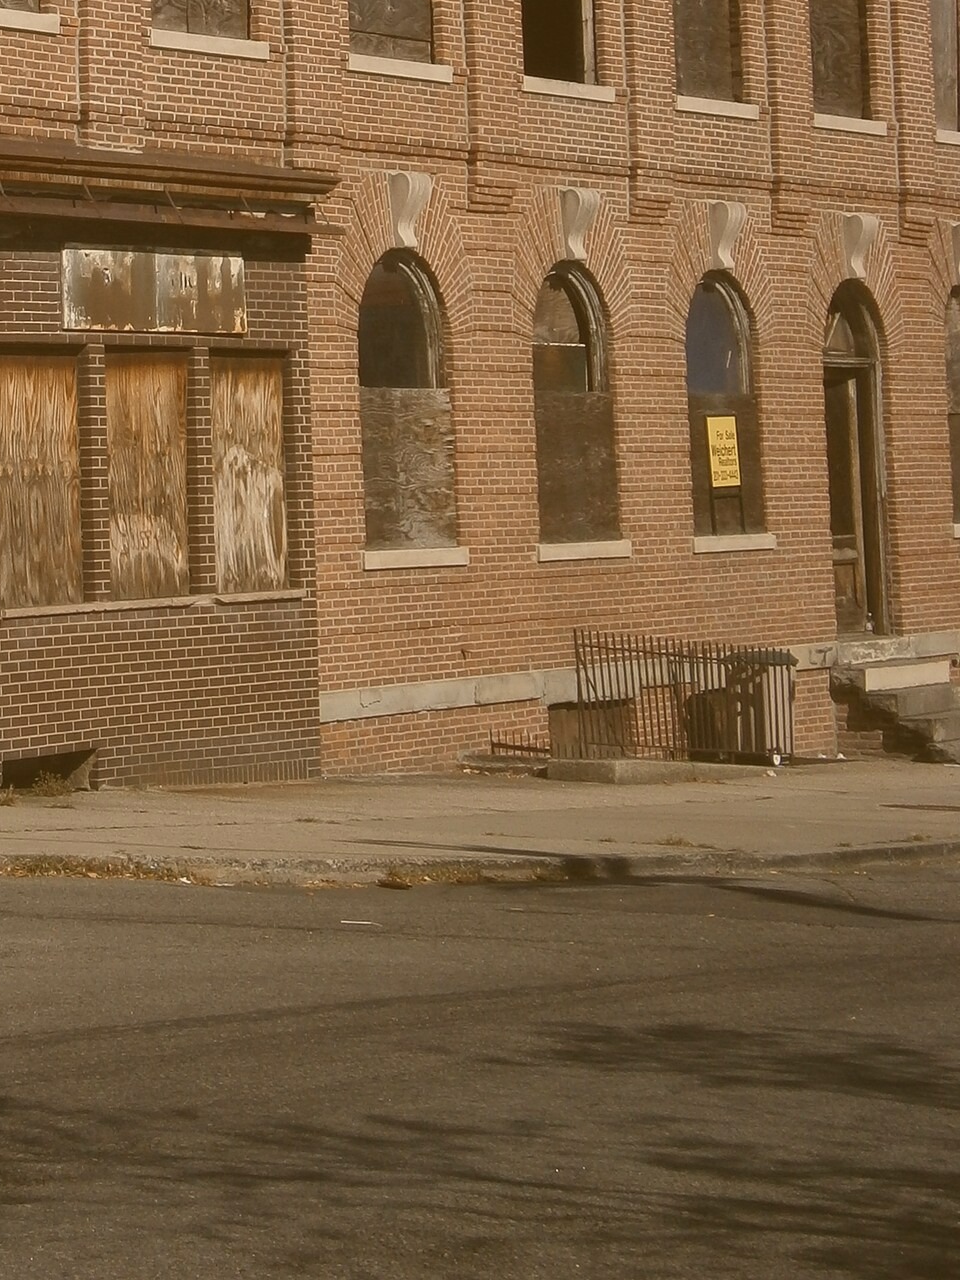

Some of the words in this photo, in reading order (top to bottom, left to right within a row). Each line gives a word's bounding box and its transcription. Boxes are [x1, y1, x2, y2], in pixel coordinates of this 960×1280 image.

[716, 430, 724, 440] For
[725, 429, 736, 440] Sale
[711, 443, 737, 457] Weichert
